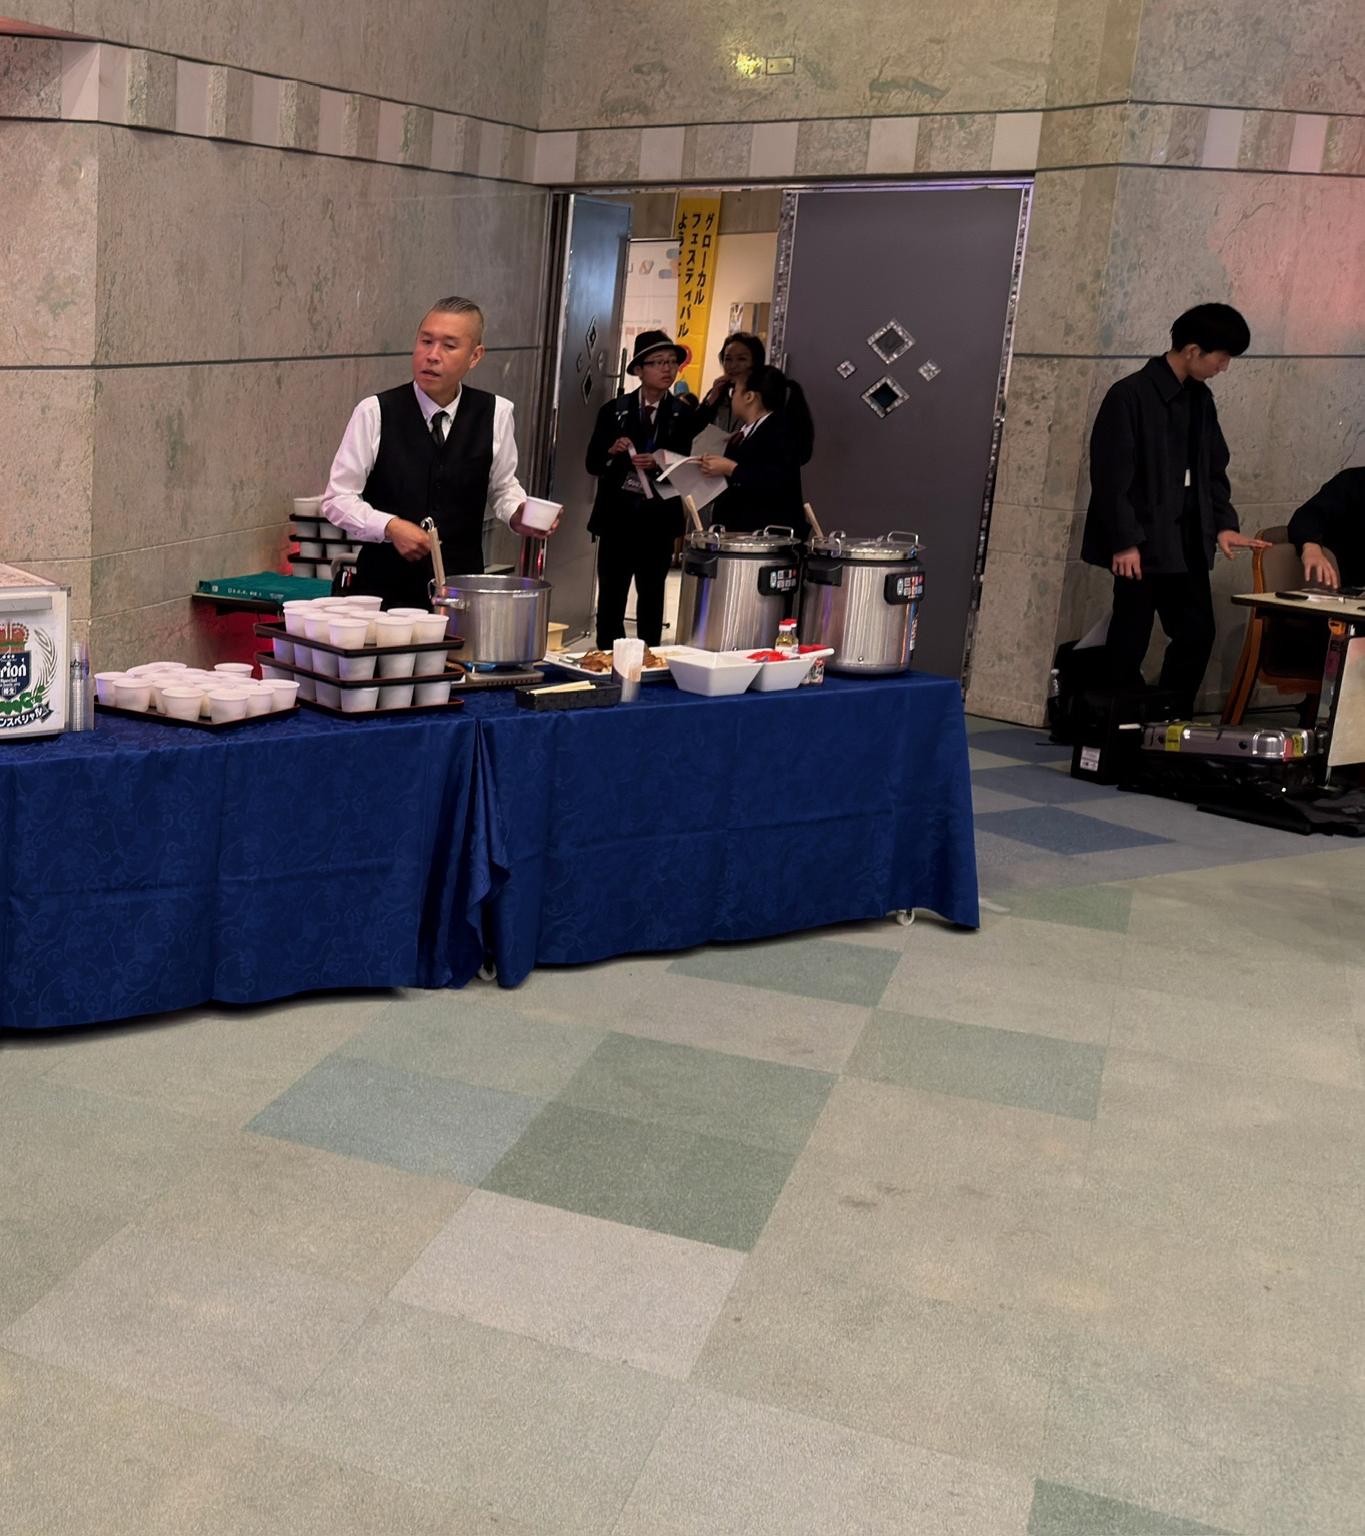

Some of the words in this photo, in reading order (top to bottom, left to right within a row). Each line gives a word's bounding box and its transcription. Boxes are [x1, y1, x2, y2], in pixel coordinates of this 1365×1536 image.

[677, 212, 687, 277] よう
[678, 213, 702, 338] フェスティバル
[693, 213, 715, 305] グローカル
